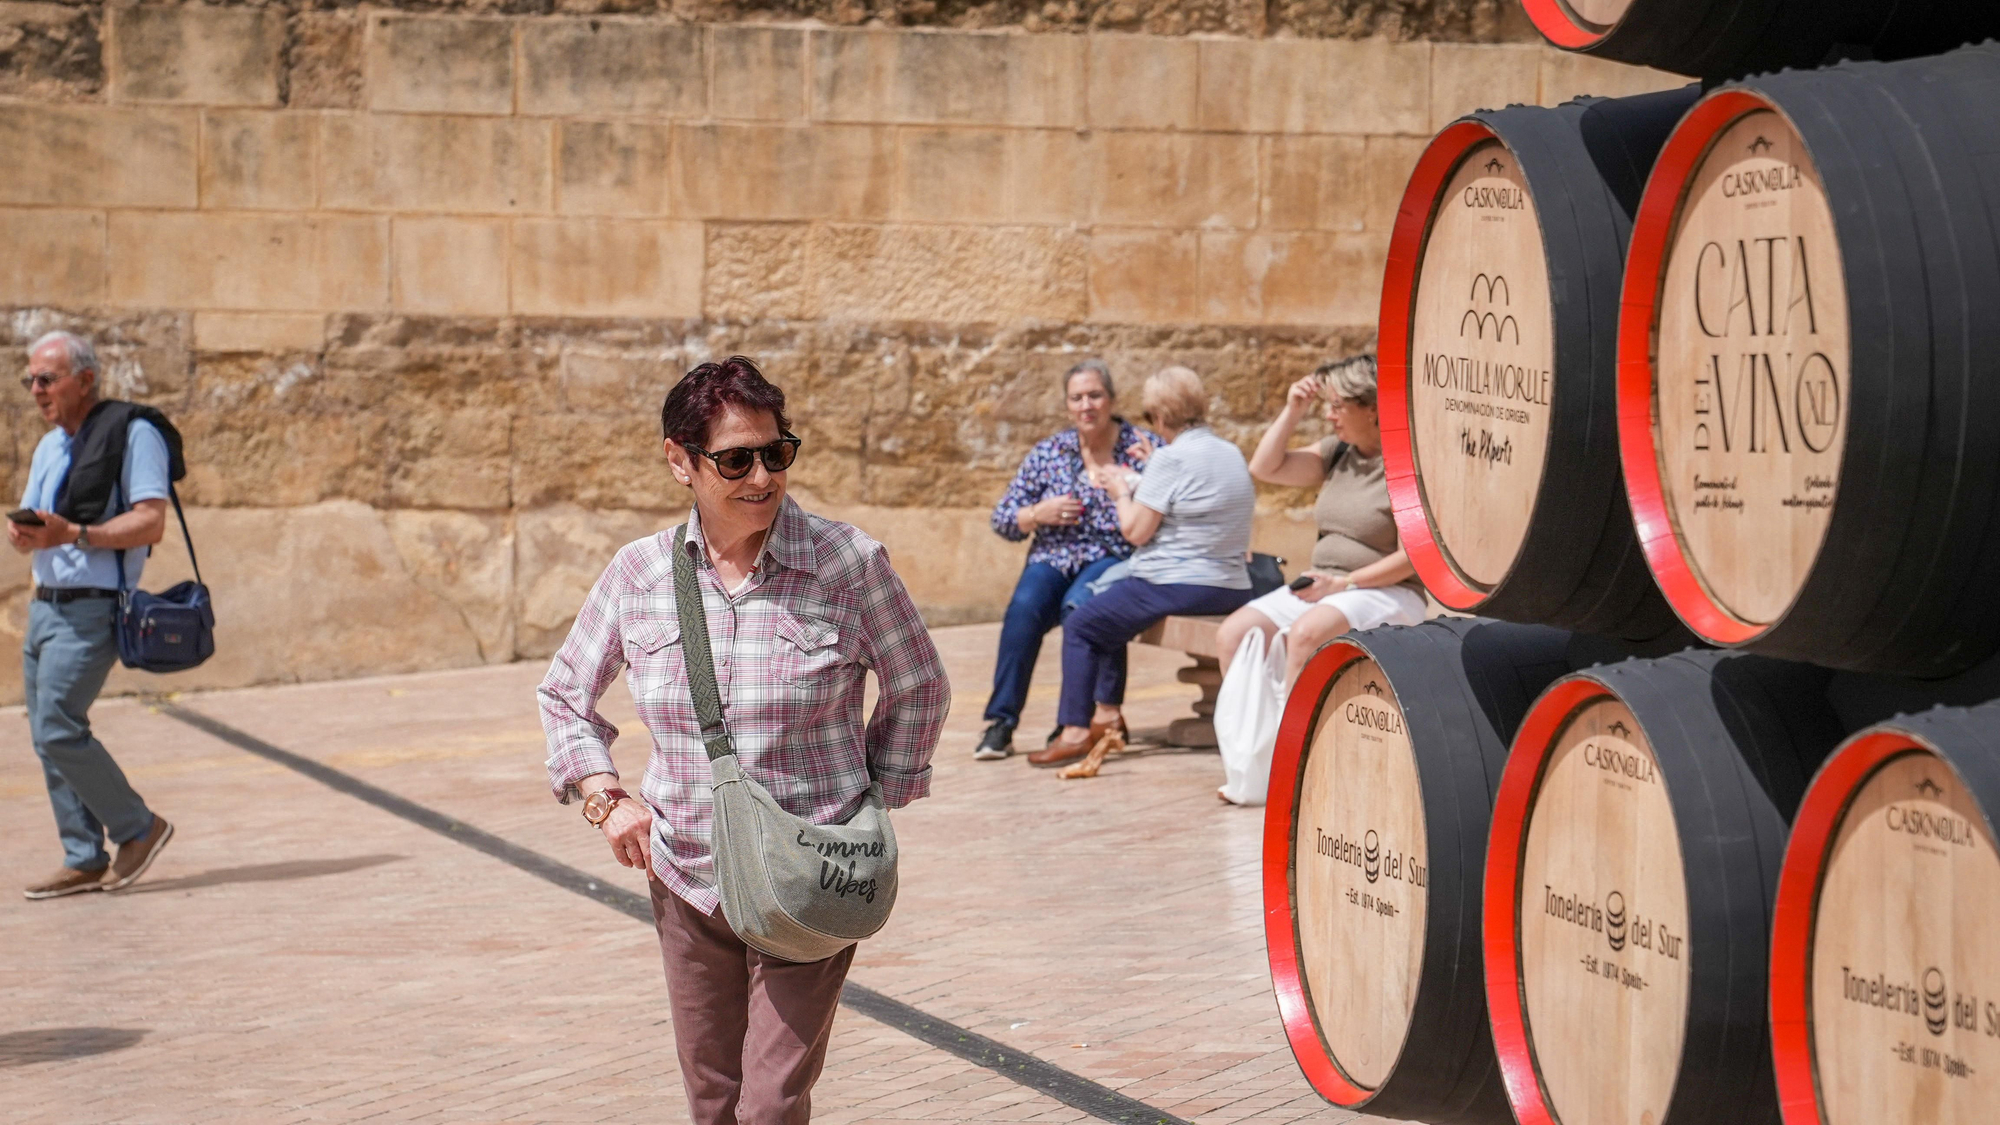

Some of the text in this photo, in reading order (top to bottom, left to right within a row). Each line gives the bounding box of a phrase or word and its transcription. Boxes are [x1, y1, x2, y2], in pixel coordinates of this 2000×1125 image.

[1464, 186, 1524, 210] CASKNOLIA
[1722, 165, 1803, 198] CASKNOLIA
[1695, 237, 1818, 338] CATA
[1423, 353, 1490, 396] MONTILLA
[1496, 406, 1504, 420] DE
[1505, 408, 1530, 425] ORIGEN
[1694, 363, 1711, 451] DEL
[1711, 353, 1841, 454] VINO
[1461, 427, 1476, 458] the
[1346, 703, 1403, 735] CASKNOLIA
[1584, 744, 1656, 785] CASKNOLIA
[1317, 827, 1426, 889] Tonelería del Sur
[820, 860, 878, 904] Vibes
[1545, 885, 1683, 960] Tonelería del Sur
[1841, 965, 1919, 1016] Tonelería
[1953, 991, 1978, 1033] del
